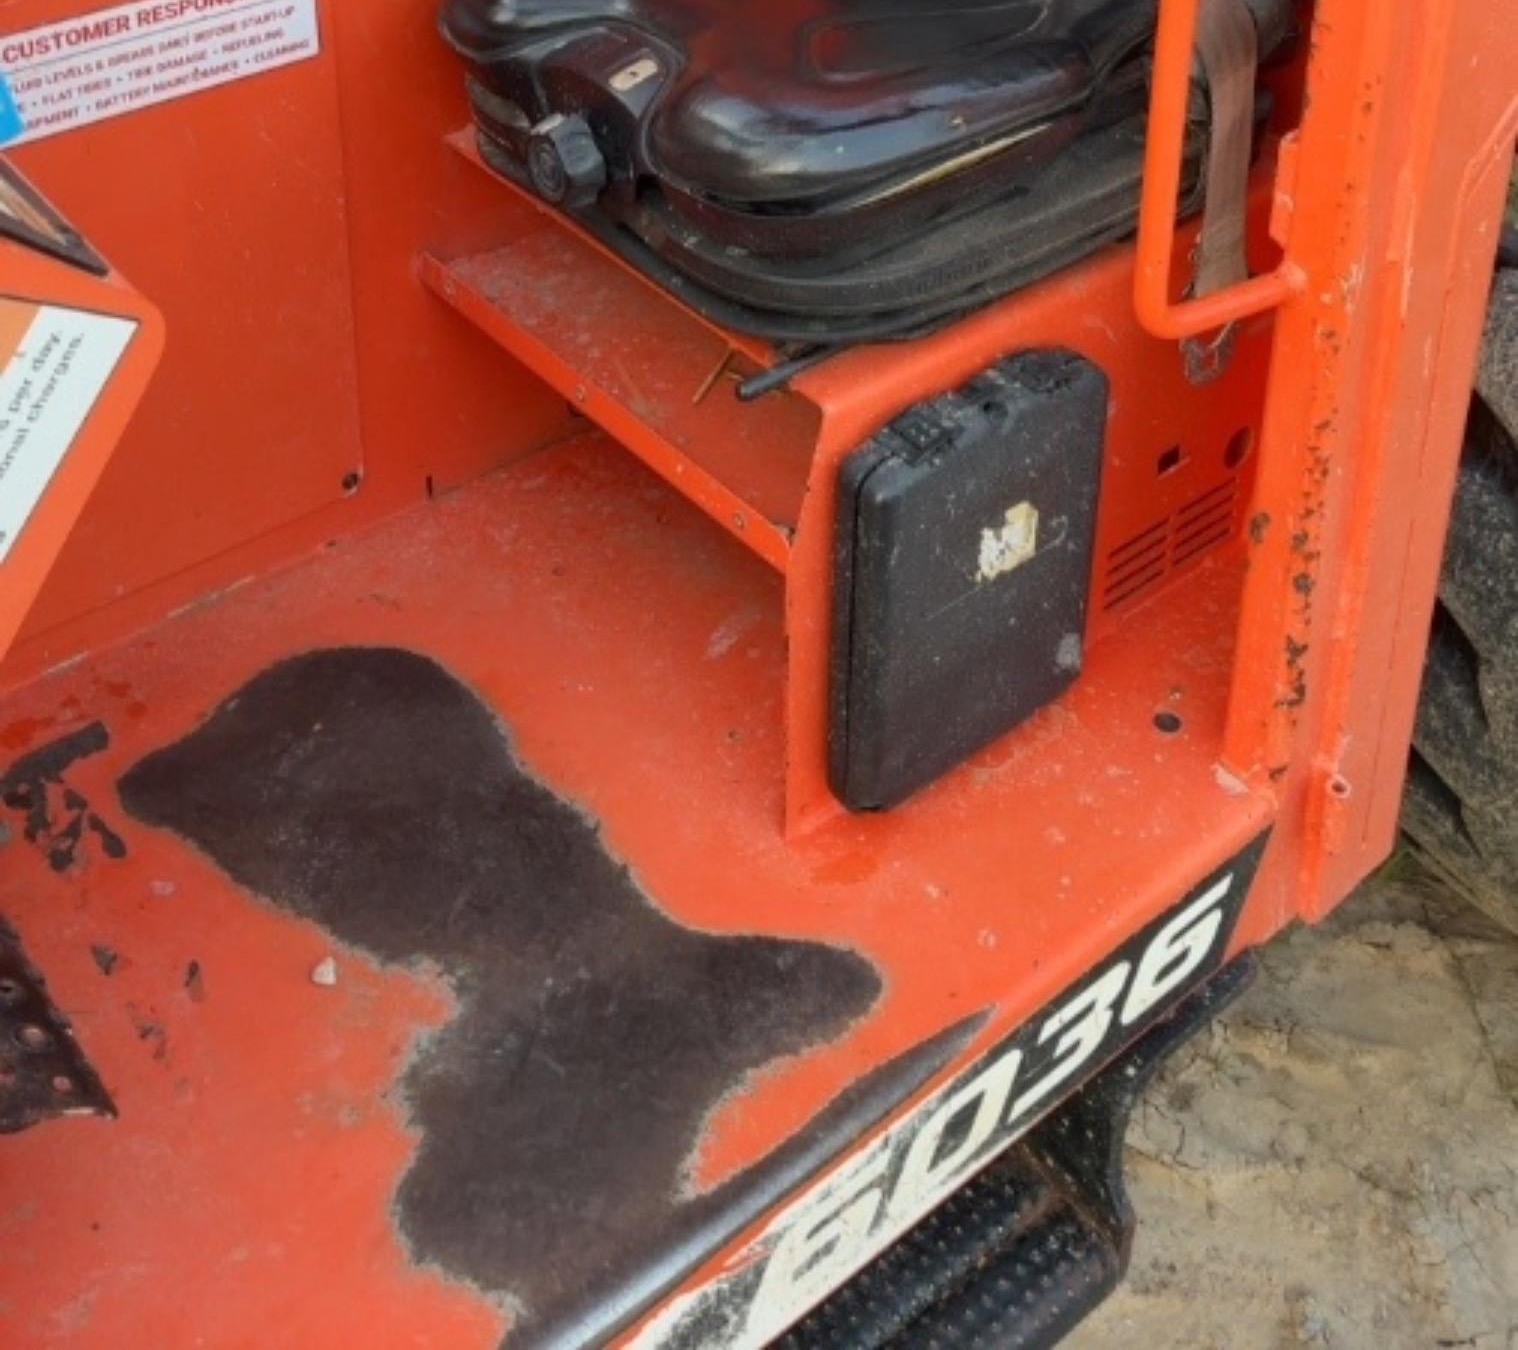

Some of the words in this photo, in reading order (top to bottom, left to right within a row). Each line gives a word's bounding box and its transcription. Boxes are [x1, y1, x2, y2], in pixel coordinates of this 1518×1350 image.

[2, 15, 130, 64] CUSTOMER
[41, 88, 73, 105] FLAT
[95, 85, 151, 111] BATTERY
[745, 872, 1234, 1350] 6036
